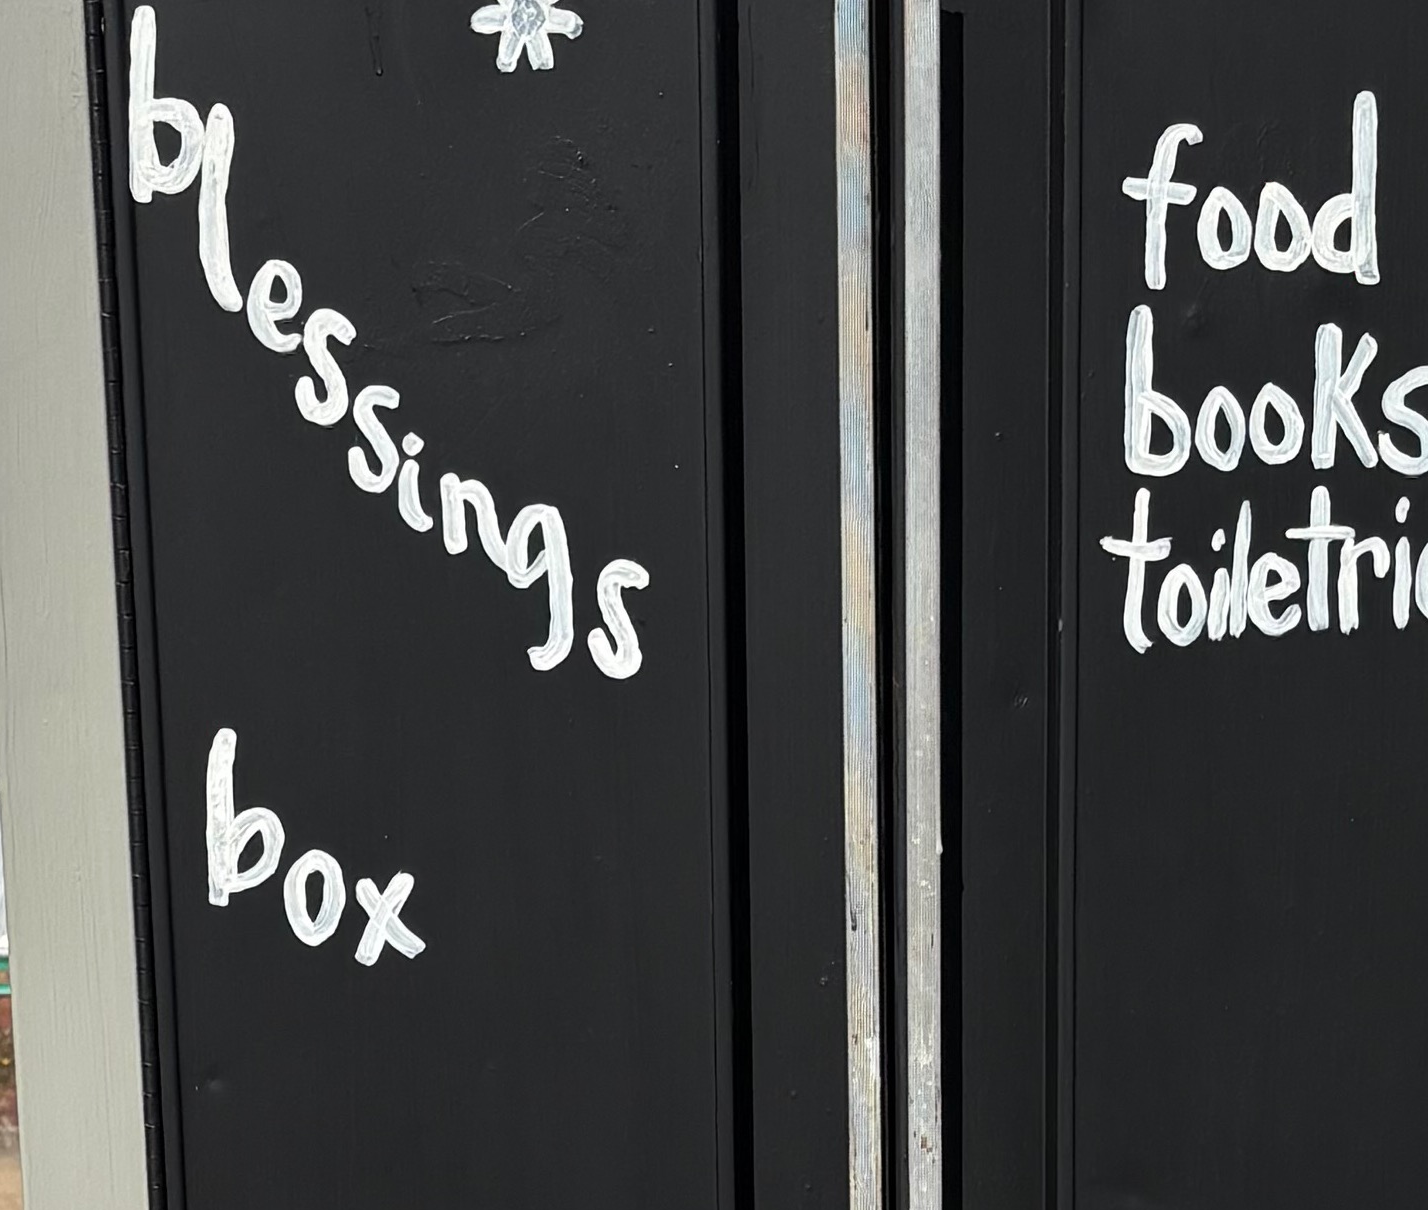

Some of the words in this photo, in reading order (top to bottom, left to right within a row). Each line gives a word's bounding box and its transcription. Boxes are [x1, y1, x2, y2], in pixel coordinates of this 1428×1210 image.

[1121, 90, 1381, 291] food
[128, 4, 650, 680] blessings
[205, 727, 427, 966] box
